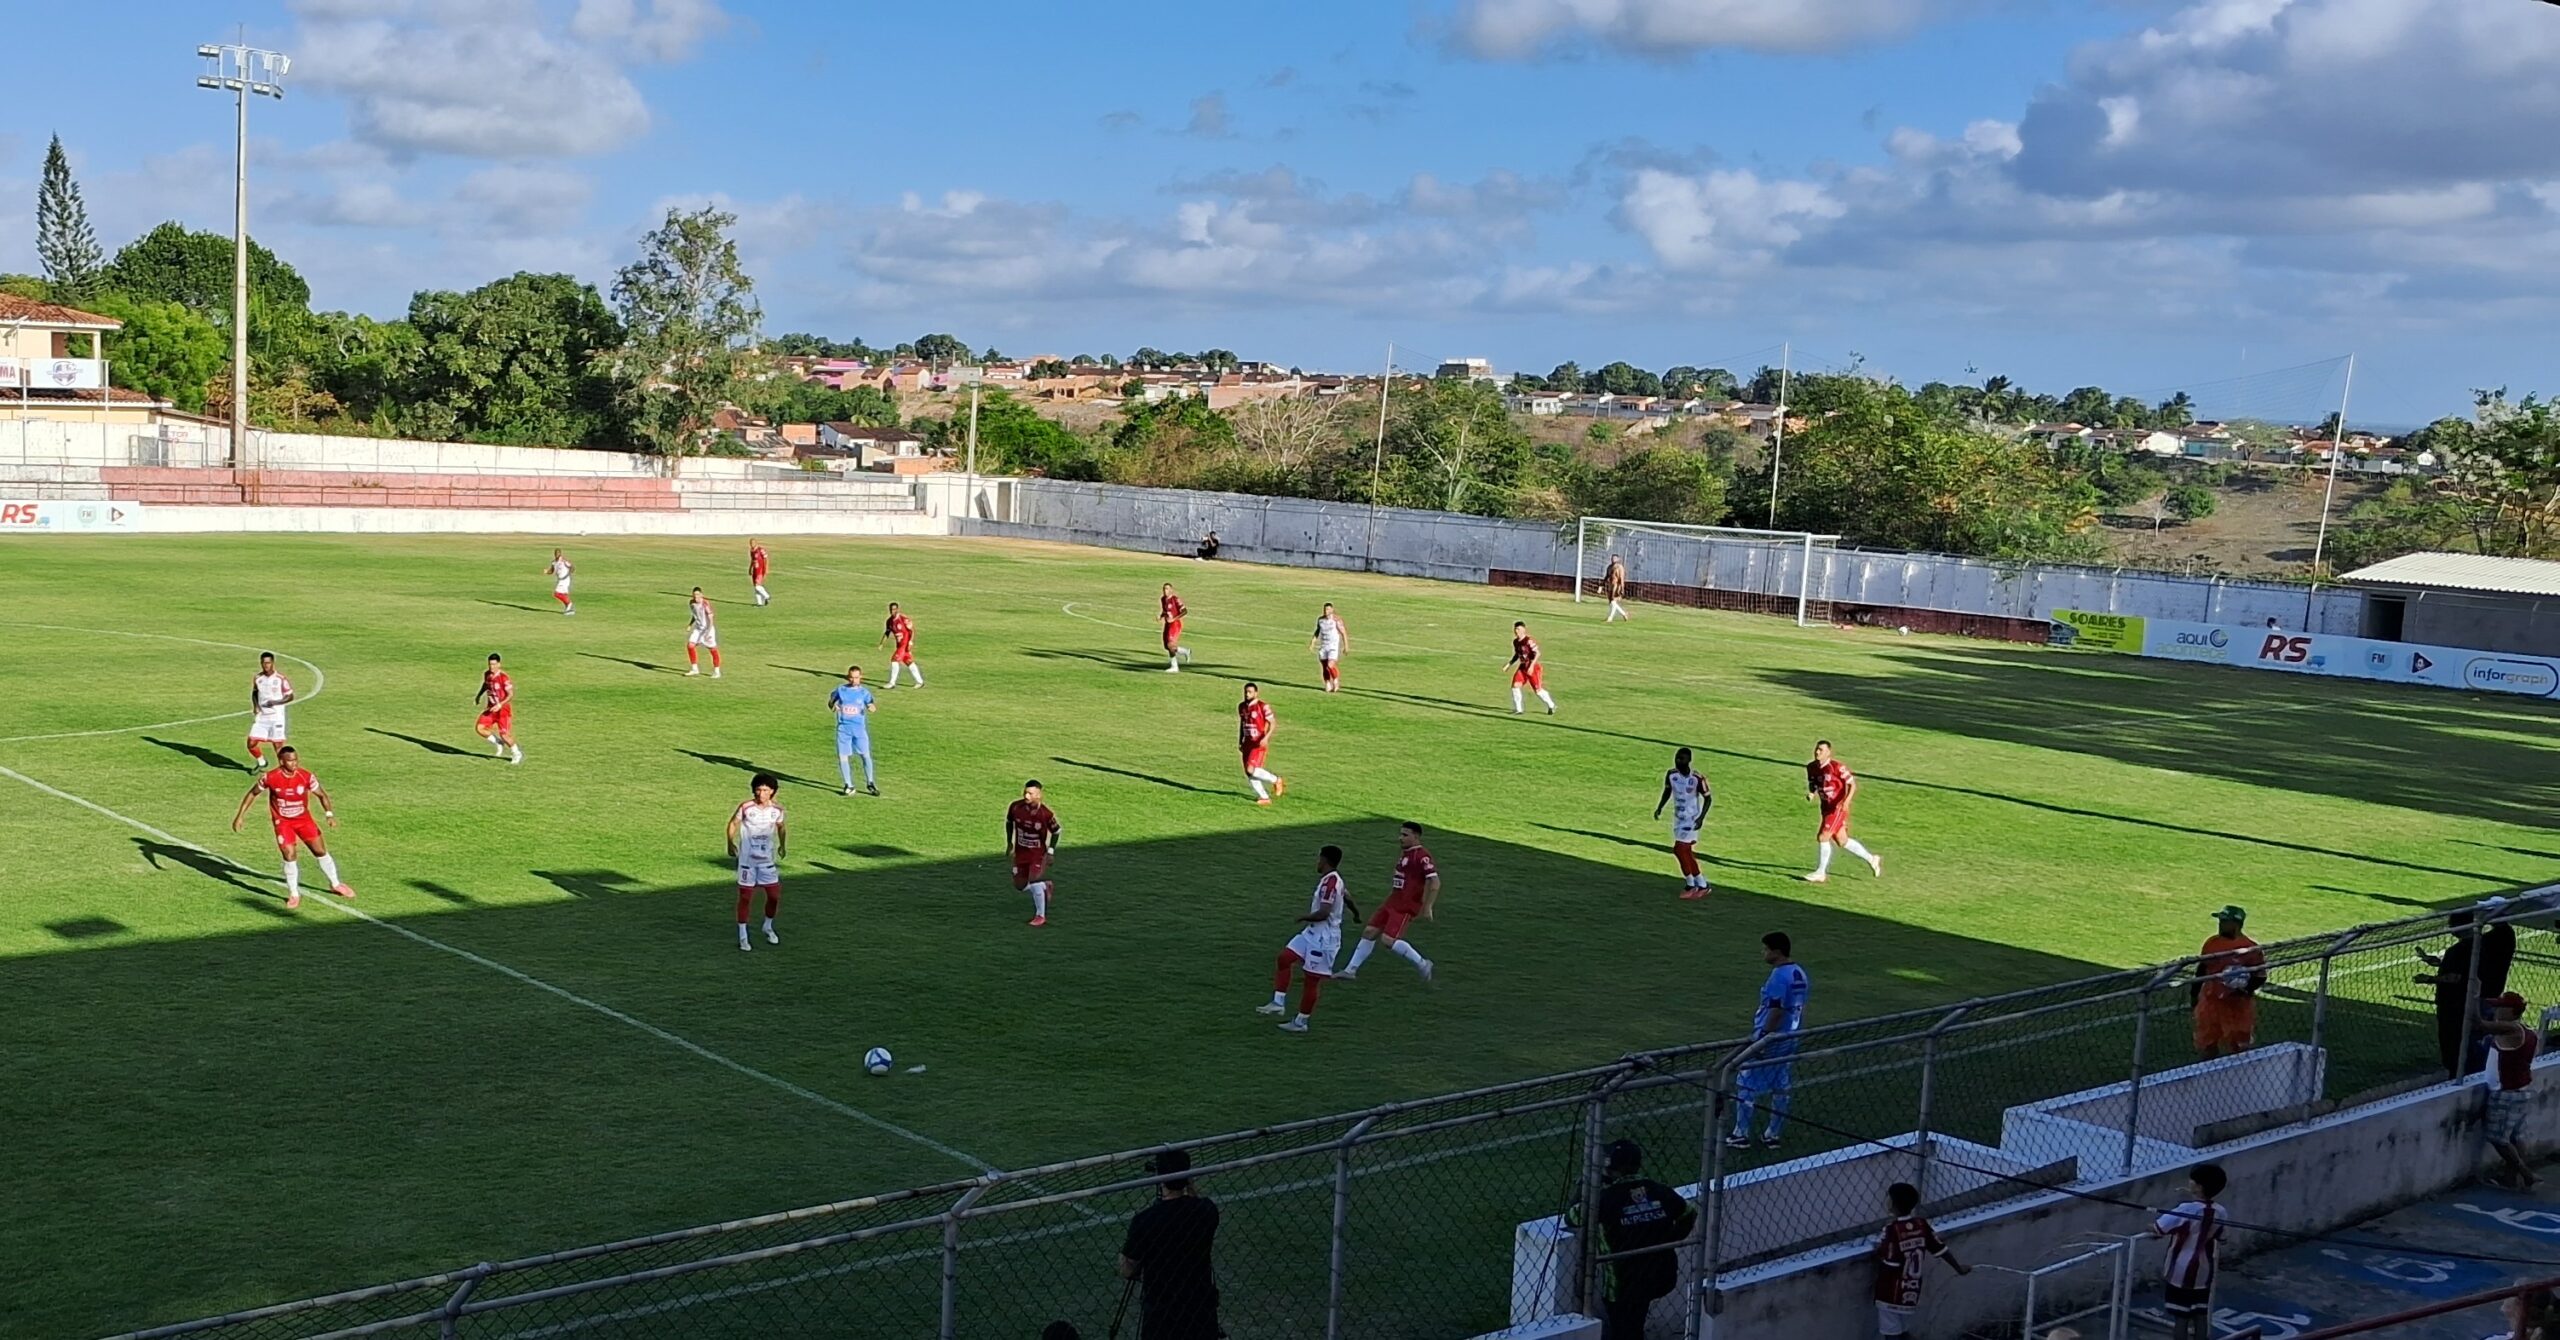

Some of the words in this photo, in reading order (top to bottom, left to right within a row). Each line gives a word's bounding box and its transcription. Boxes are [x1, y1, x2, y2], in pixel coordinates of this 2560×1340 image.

[0, 503, 39, 524] RS
[2068, 611, 2127, 629] SOARES
[2176, 631, 2208, 647] aqui
[2258, 633, 2313, 663] RS
[2155, 641, 2229, 661] acontece
[2371, 652, 2386, 665] FM
[2473, 666, 2549, 686] inforgraph
